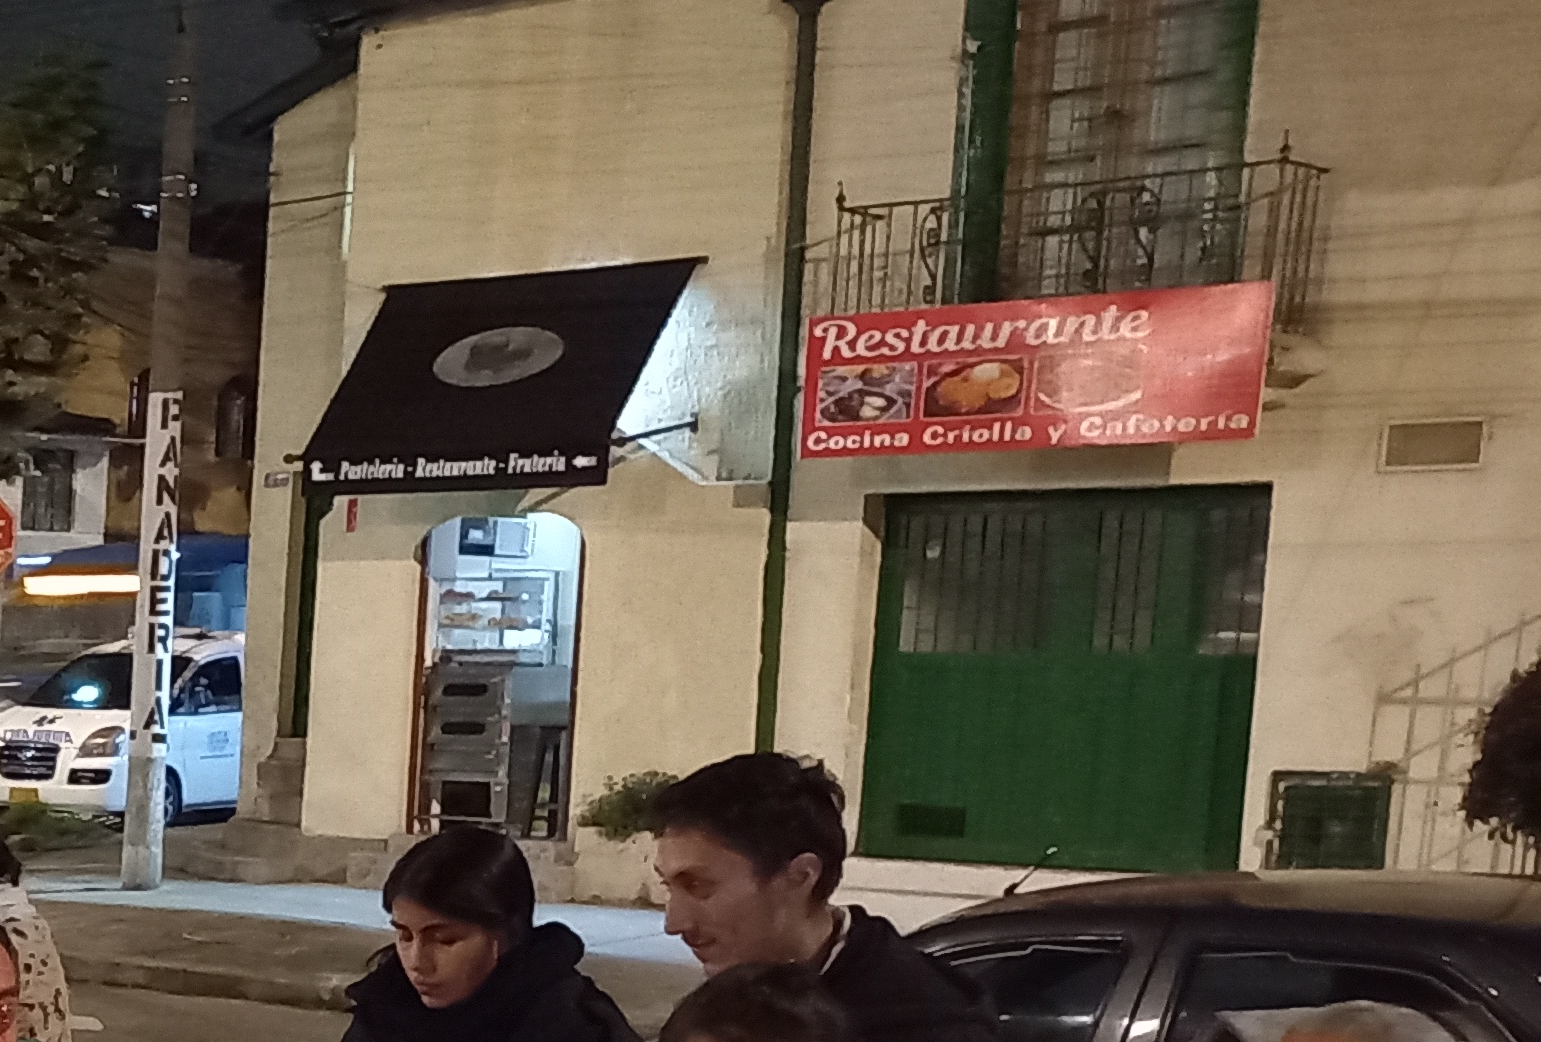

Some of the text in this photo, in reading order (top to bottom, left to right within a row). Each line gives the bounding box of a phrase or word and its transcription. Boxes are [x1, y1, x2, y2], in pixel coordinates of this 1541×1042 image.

[813, 304, 1151, 360] Restaurante
[806, 429, 910, 451] Cocina
[922, 419, 1032, 446] Criolla
[1048, 423, 1066, 444] y
[415, 455, 496, 478] Restaurante
[142, 397, 180, 731] PANADERIA
